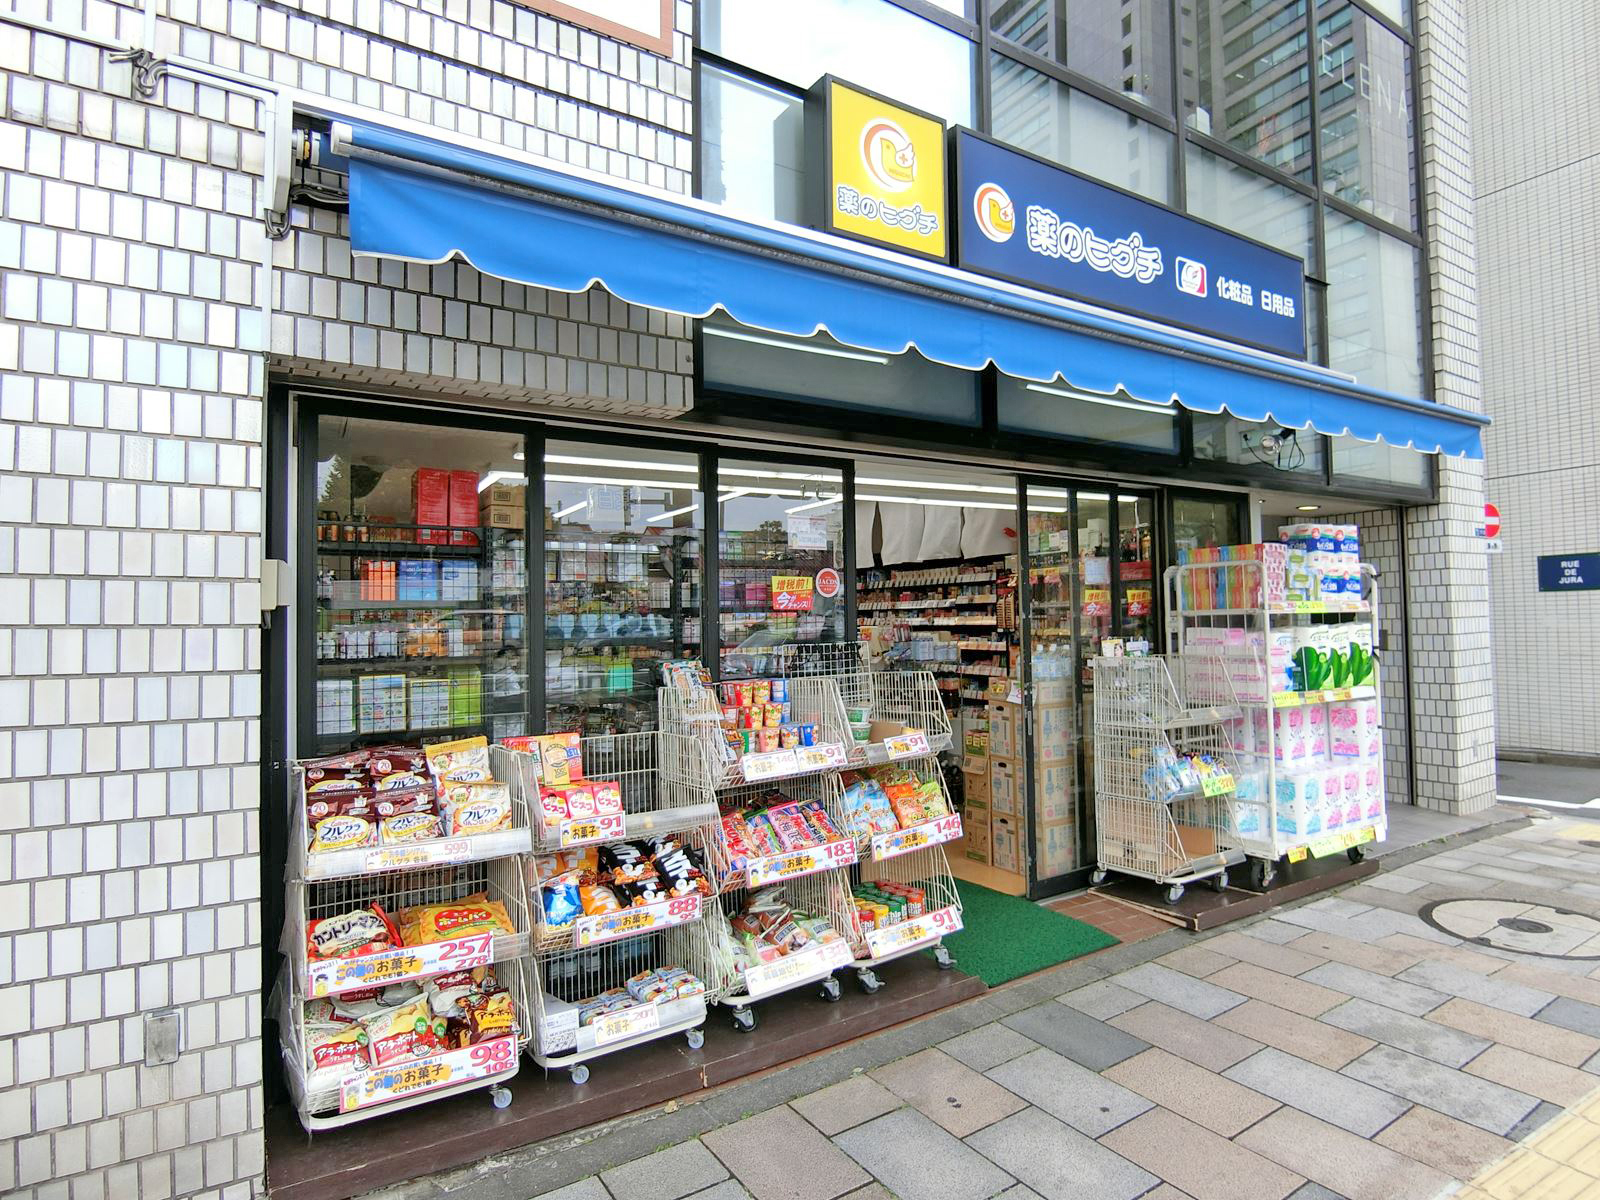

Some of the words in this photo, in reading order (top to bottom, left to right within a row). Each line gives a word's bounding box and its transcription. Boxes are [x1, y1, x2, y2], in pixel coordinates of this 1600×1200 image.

[837, 184, 939, 235] 薬のヒグチ
[1026, 205, 1163, 283] 薬のヒグチ
[1216, 276, 1254, 306] 化粧品
[1261, 290, 1296, 318] 日用品
[1564, 568, 1577, 576] DE
[1559, 576, 1584, 584] JURA
[825, 747, 842, 757] 91
[312, 805, 326, 813] 70
[379, 805, 392, 813] 70
[543, 802, 565, 814] ビスコ
[571, 799, 593, 811] ビスコ
[598, 796, 619, 808] ビスコ
[462, 808, 498, 822] フルグラ
[600, 816, 622, 829] 91
[323, 824, 361, 837] フルグラ
[934, 816, 961, 833] 146
[572, 825, 597, 840] お菓子
[444, 841, 469, 855] 599
[824, 840, 856, 859] 183
[668, 896, 698, 916] 88
[932, 909, 954, 928] 91
[438, 935, 493, 961] 257
[454, 954, 488, 970] 278
[606, 1019, 630, 1036] お菓子
[469, 1040, 512, 1067] 98
[481, 1058, 514, 1076] 106
